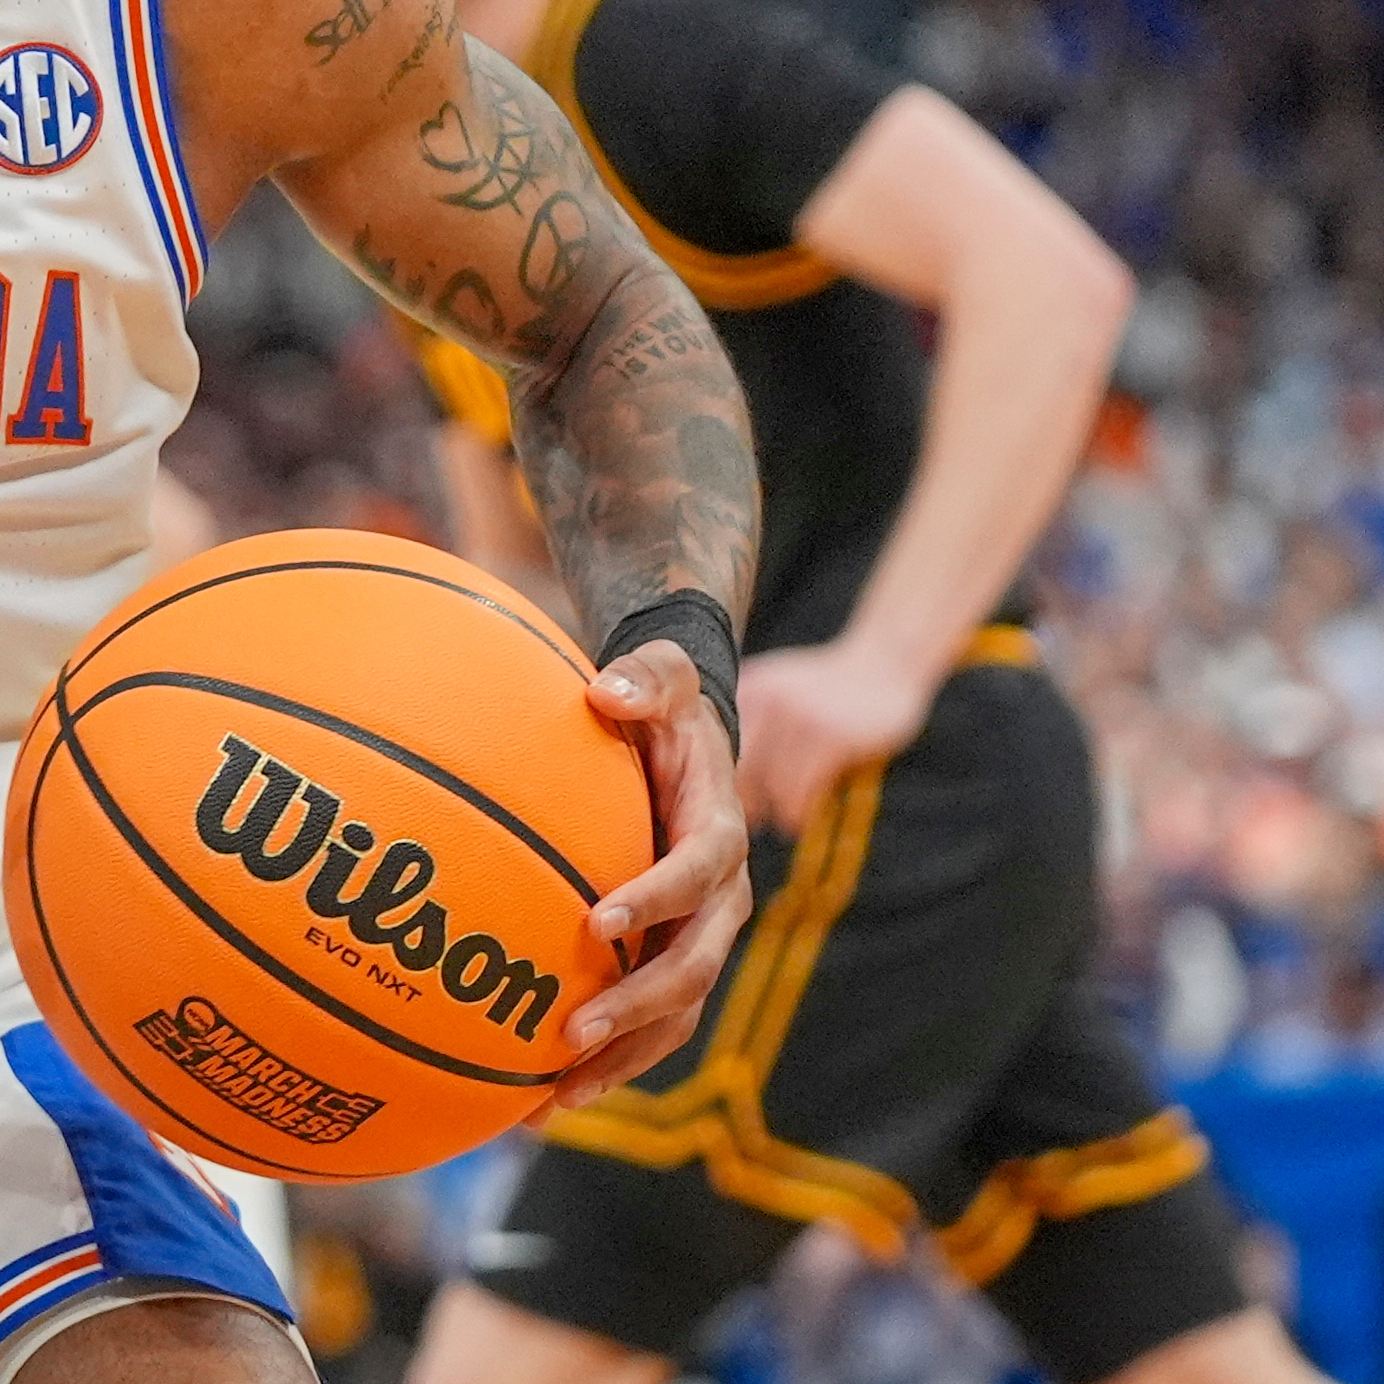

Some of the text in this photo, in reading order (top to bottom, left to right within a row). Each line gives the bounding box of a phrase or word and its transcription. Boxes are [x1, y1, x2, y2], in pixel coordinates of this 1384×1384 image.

[195, 730, 561, 1043] Wilson
[304, 926, 423, 1003] EVO NXT
[197, 1054, 352, 1142] MADNESS
[205, 1024, 324, 1104] MARCH
